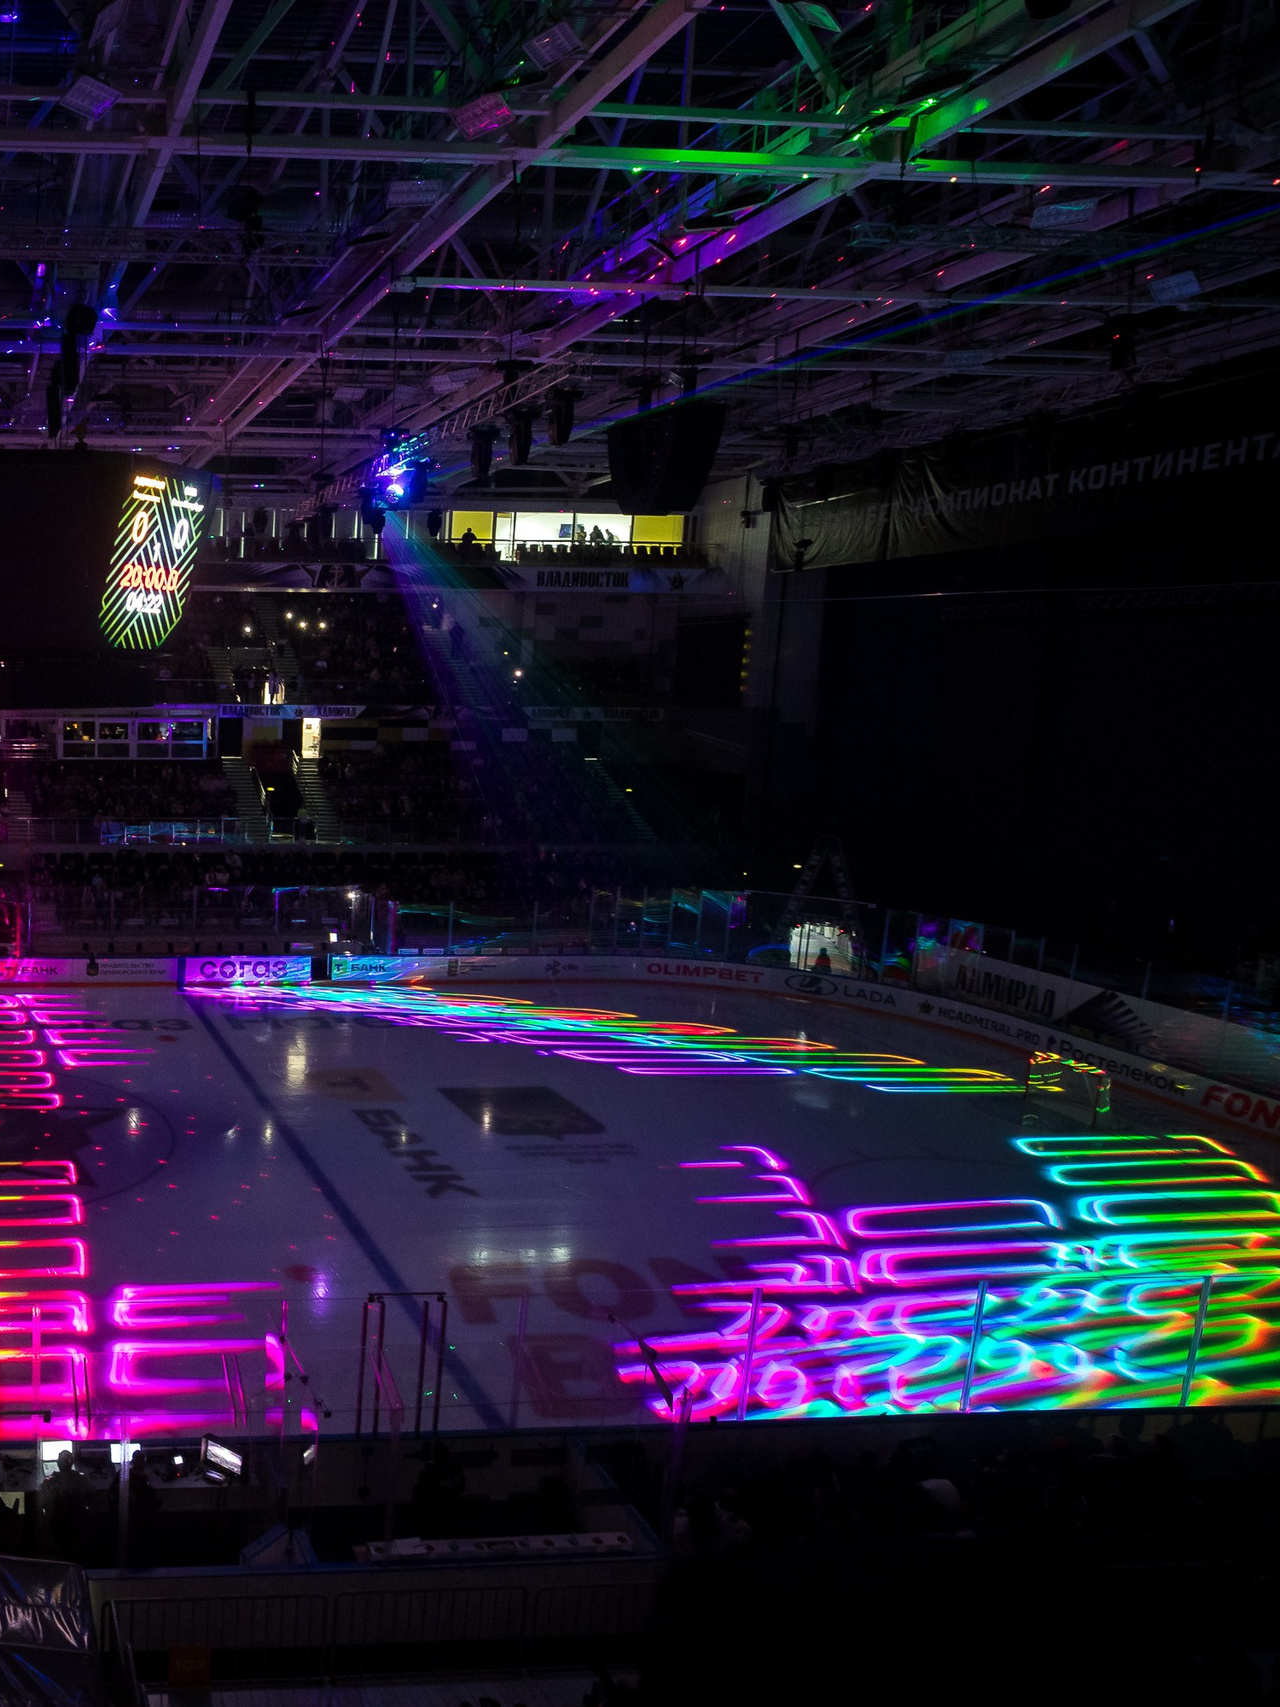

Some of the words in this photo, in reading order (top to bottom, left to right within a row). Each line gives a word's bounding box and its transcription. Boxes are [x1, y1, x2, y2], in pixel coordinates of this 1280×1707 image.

[132, 511, 148, 543] 0
[174, 518, 189, 549] 0
[536, 570, 629, 588] ВЛАДИВОСТОК
[199, 960, 289, 979] согаз
[351, 963, 388, 973] БАНК
[646, 962, 765, 984] OLIMPBET
[842, 984, 897, 1007] LADA
[954, 963, 1056, 1020] АДМИРАЛ
[938, 1004, 1041, 1047] HCADMIRAL.PRO
[1057, 1039, 1188, 1099] Ростелеком
[351, 1109, 482, 1199] БАНК
